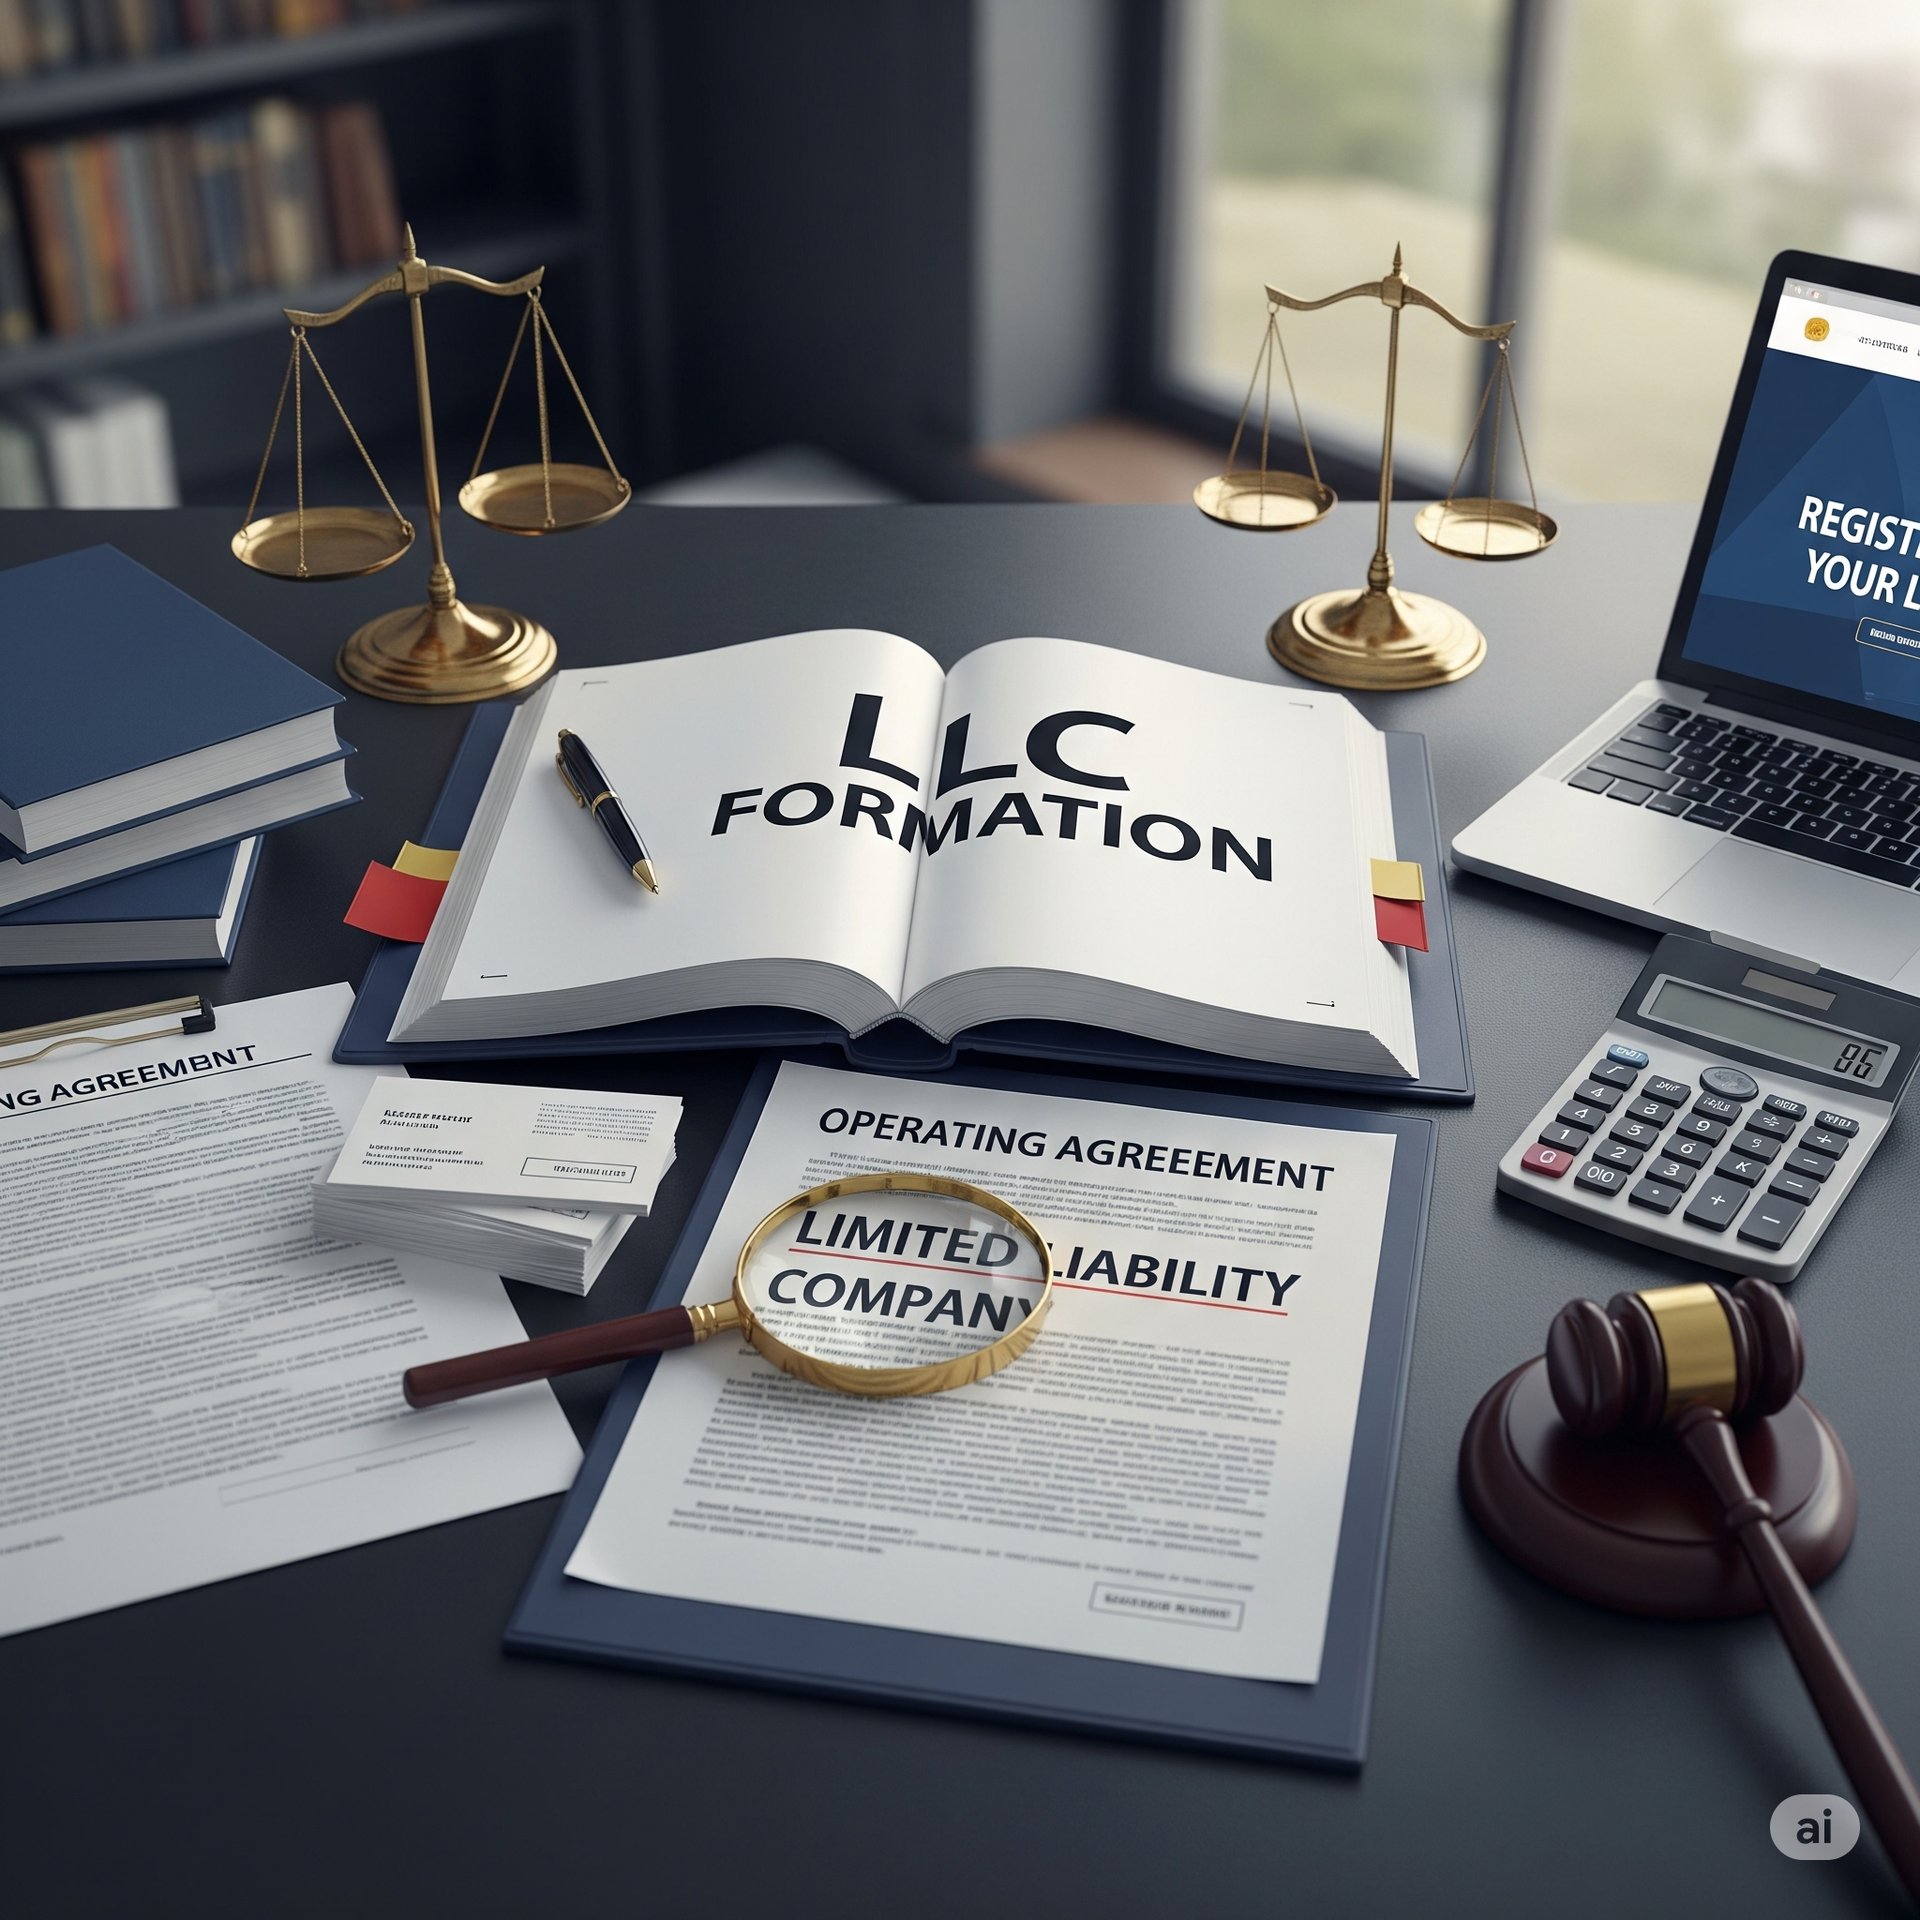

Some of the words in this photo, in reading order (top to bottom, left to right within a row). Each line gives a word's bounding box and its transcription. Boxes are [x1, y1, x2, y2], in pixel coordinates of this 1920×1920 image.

[1798, 495, 1920, 560] REGIST
[1807, 548, 1900, 604] YOUR
[839, 693, 1135, 800] LLC
[711, 781, 1272, 882] FORMATION
[1643, 1103, 1659, 1115] 8
[1627, 1124, 1644, 1136] 5
[1696, 1120, 1710, 1132] 9
[1560, 1129, 1571, 1140] 1
[819, 1107, 1047, 1157] OPERATING
[1054, 1135, 1335, 1192] AGREEEMENT
[1610, 1146, 1627, 1159] 2
[1680, 1143, 1696, 1154] 6
[1663, 1164, 1680, 1176] 3
[795, 1210, 1019, 1268] LIMITED
